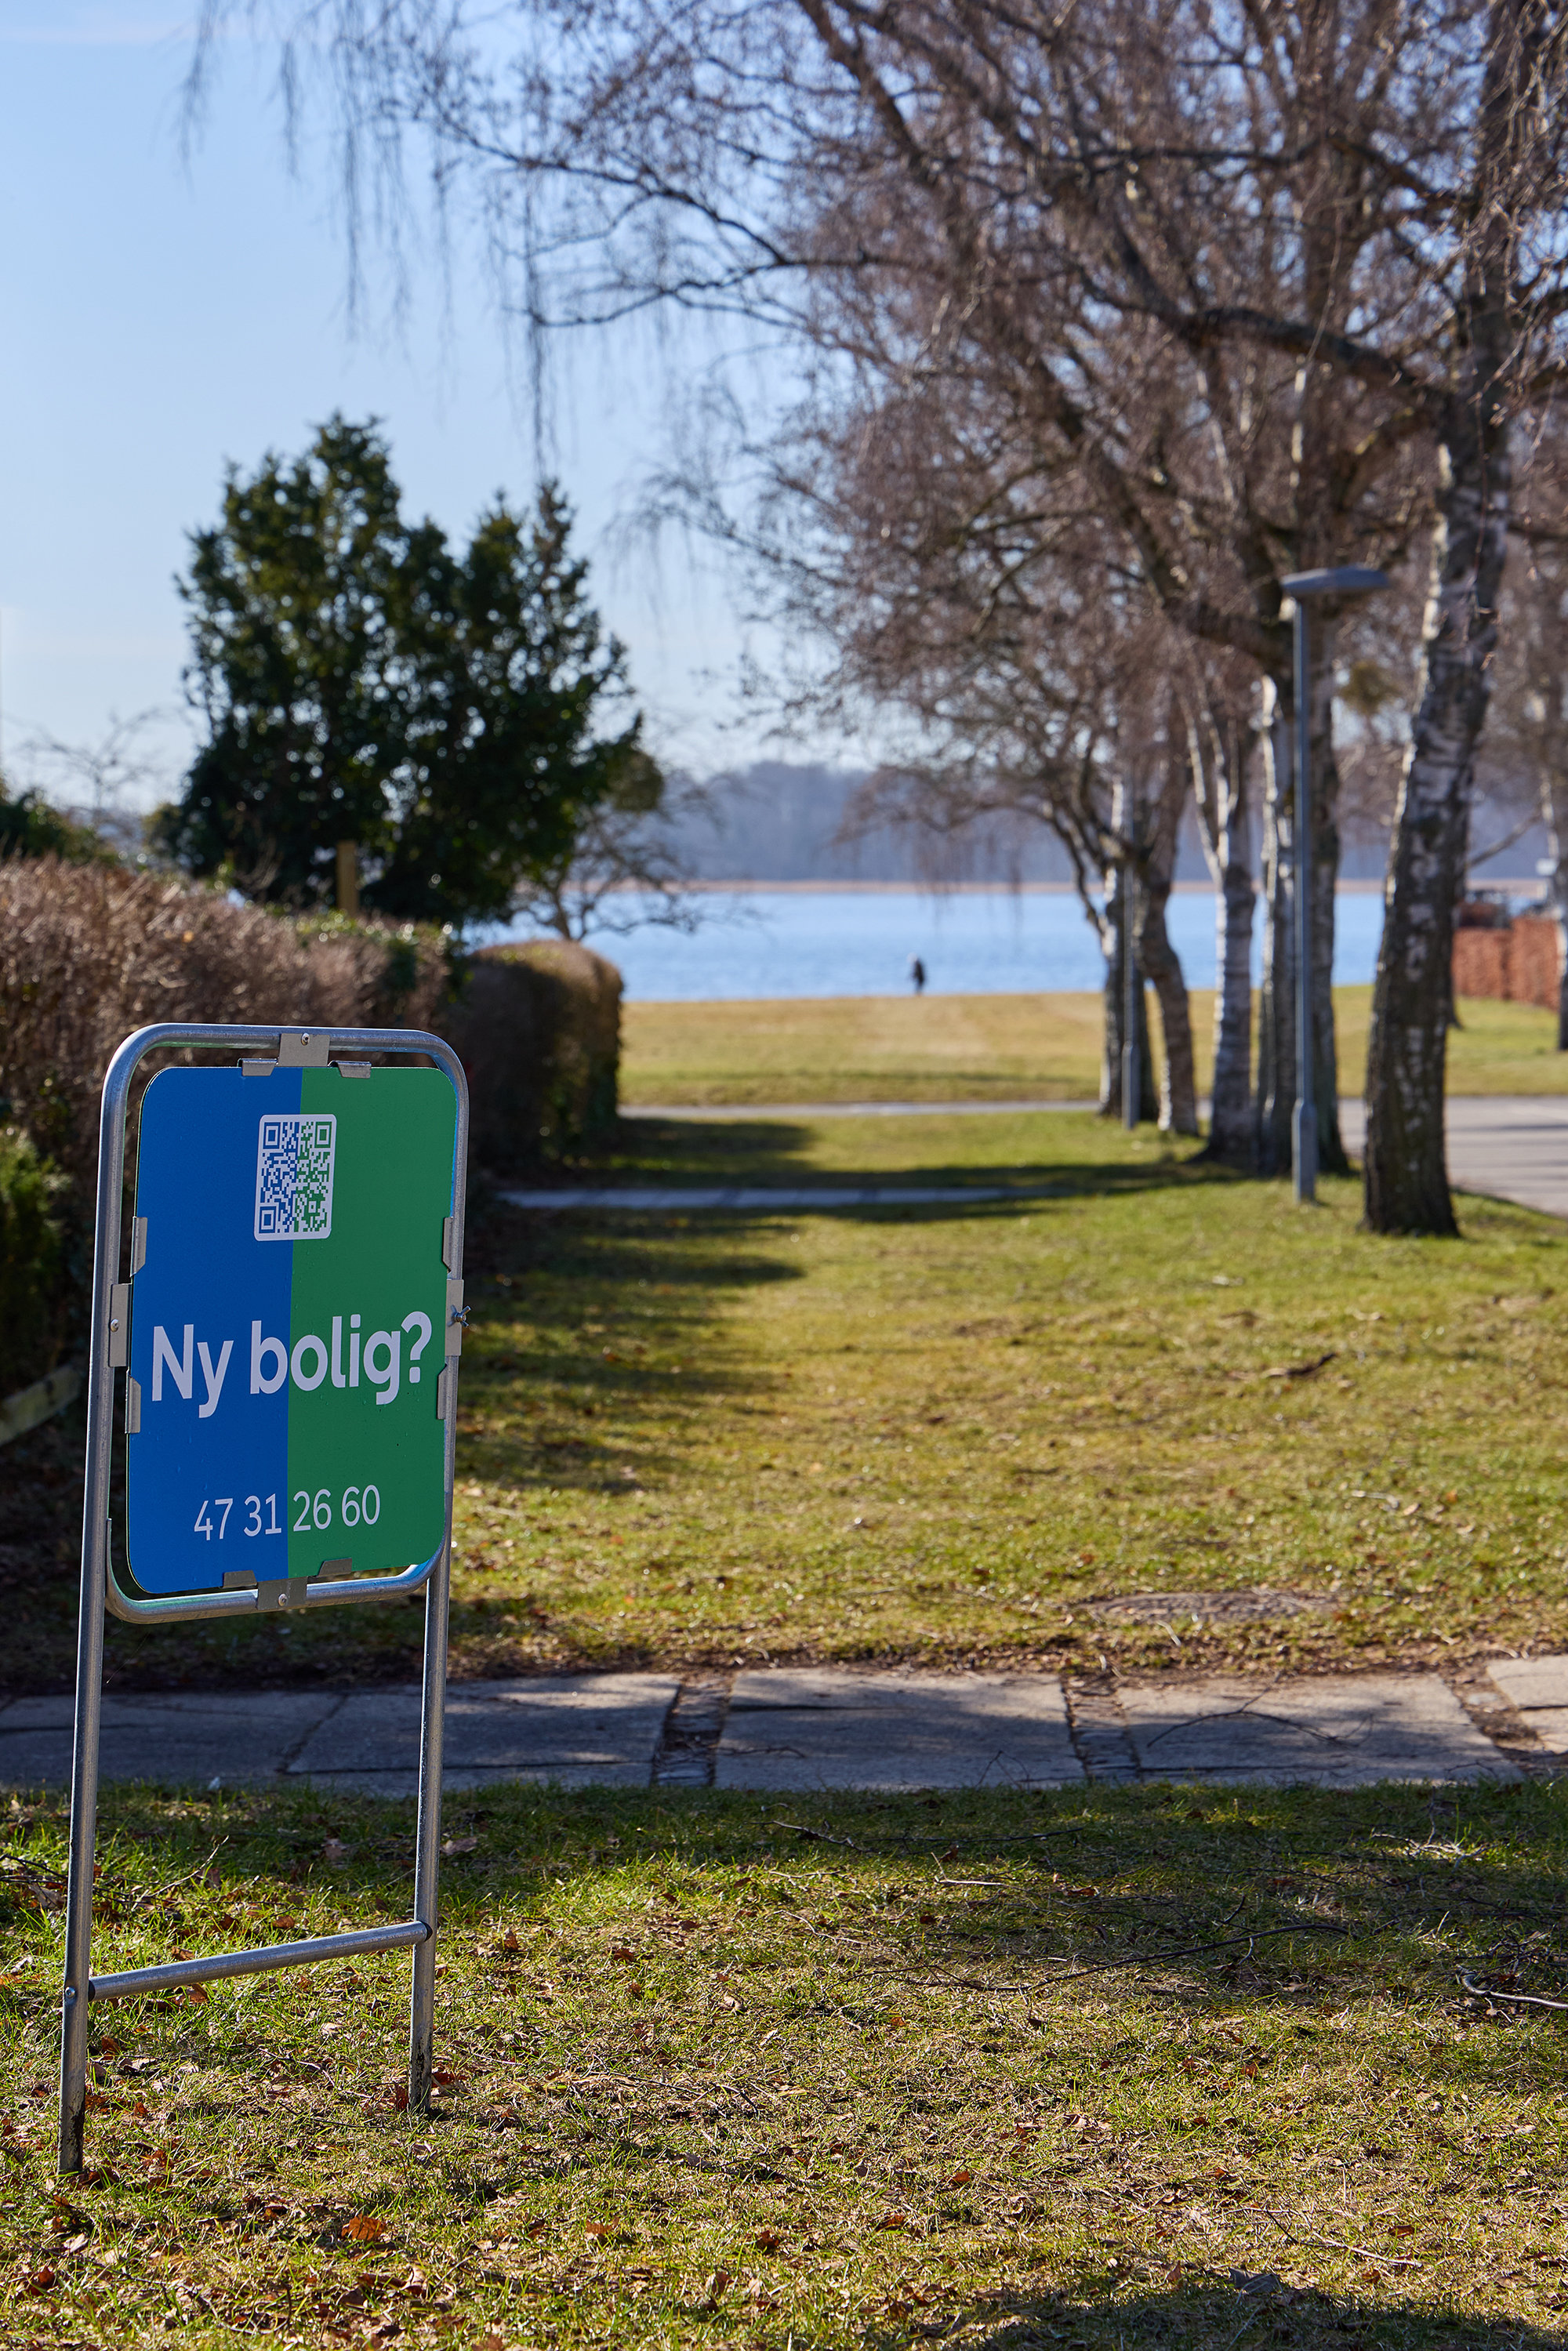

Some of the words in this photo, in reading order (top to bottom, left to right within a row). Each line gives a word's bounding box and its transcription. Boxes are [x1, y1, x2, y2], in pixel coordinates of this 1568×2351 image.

[151, 1324, 234, 1418] Ny
[250, 1311, 432, 1406] bolig?
[194, 1498, 234, 1541] 47
[243, 1493, 282, 1536] 31
[292, 1489, 332, 1532] 26
[341, 1484, 380, 1526] 60
